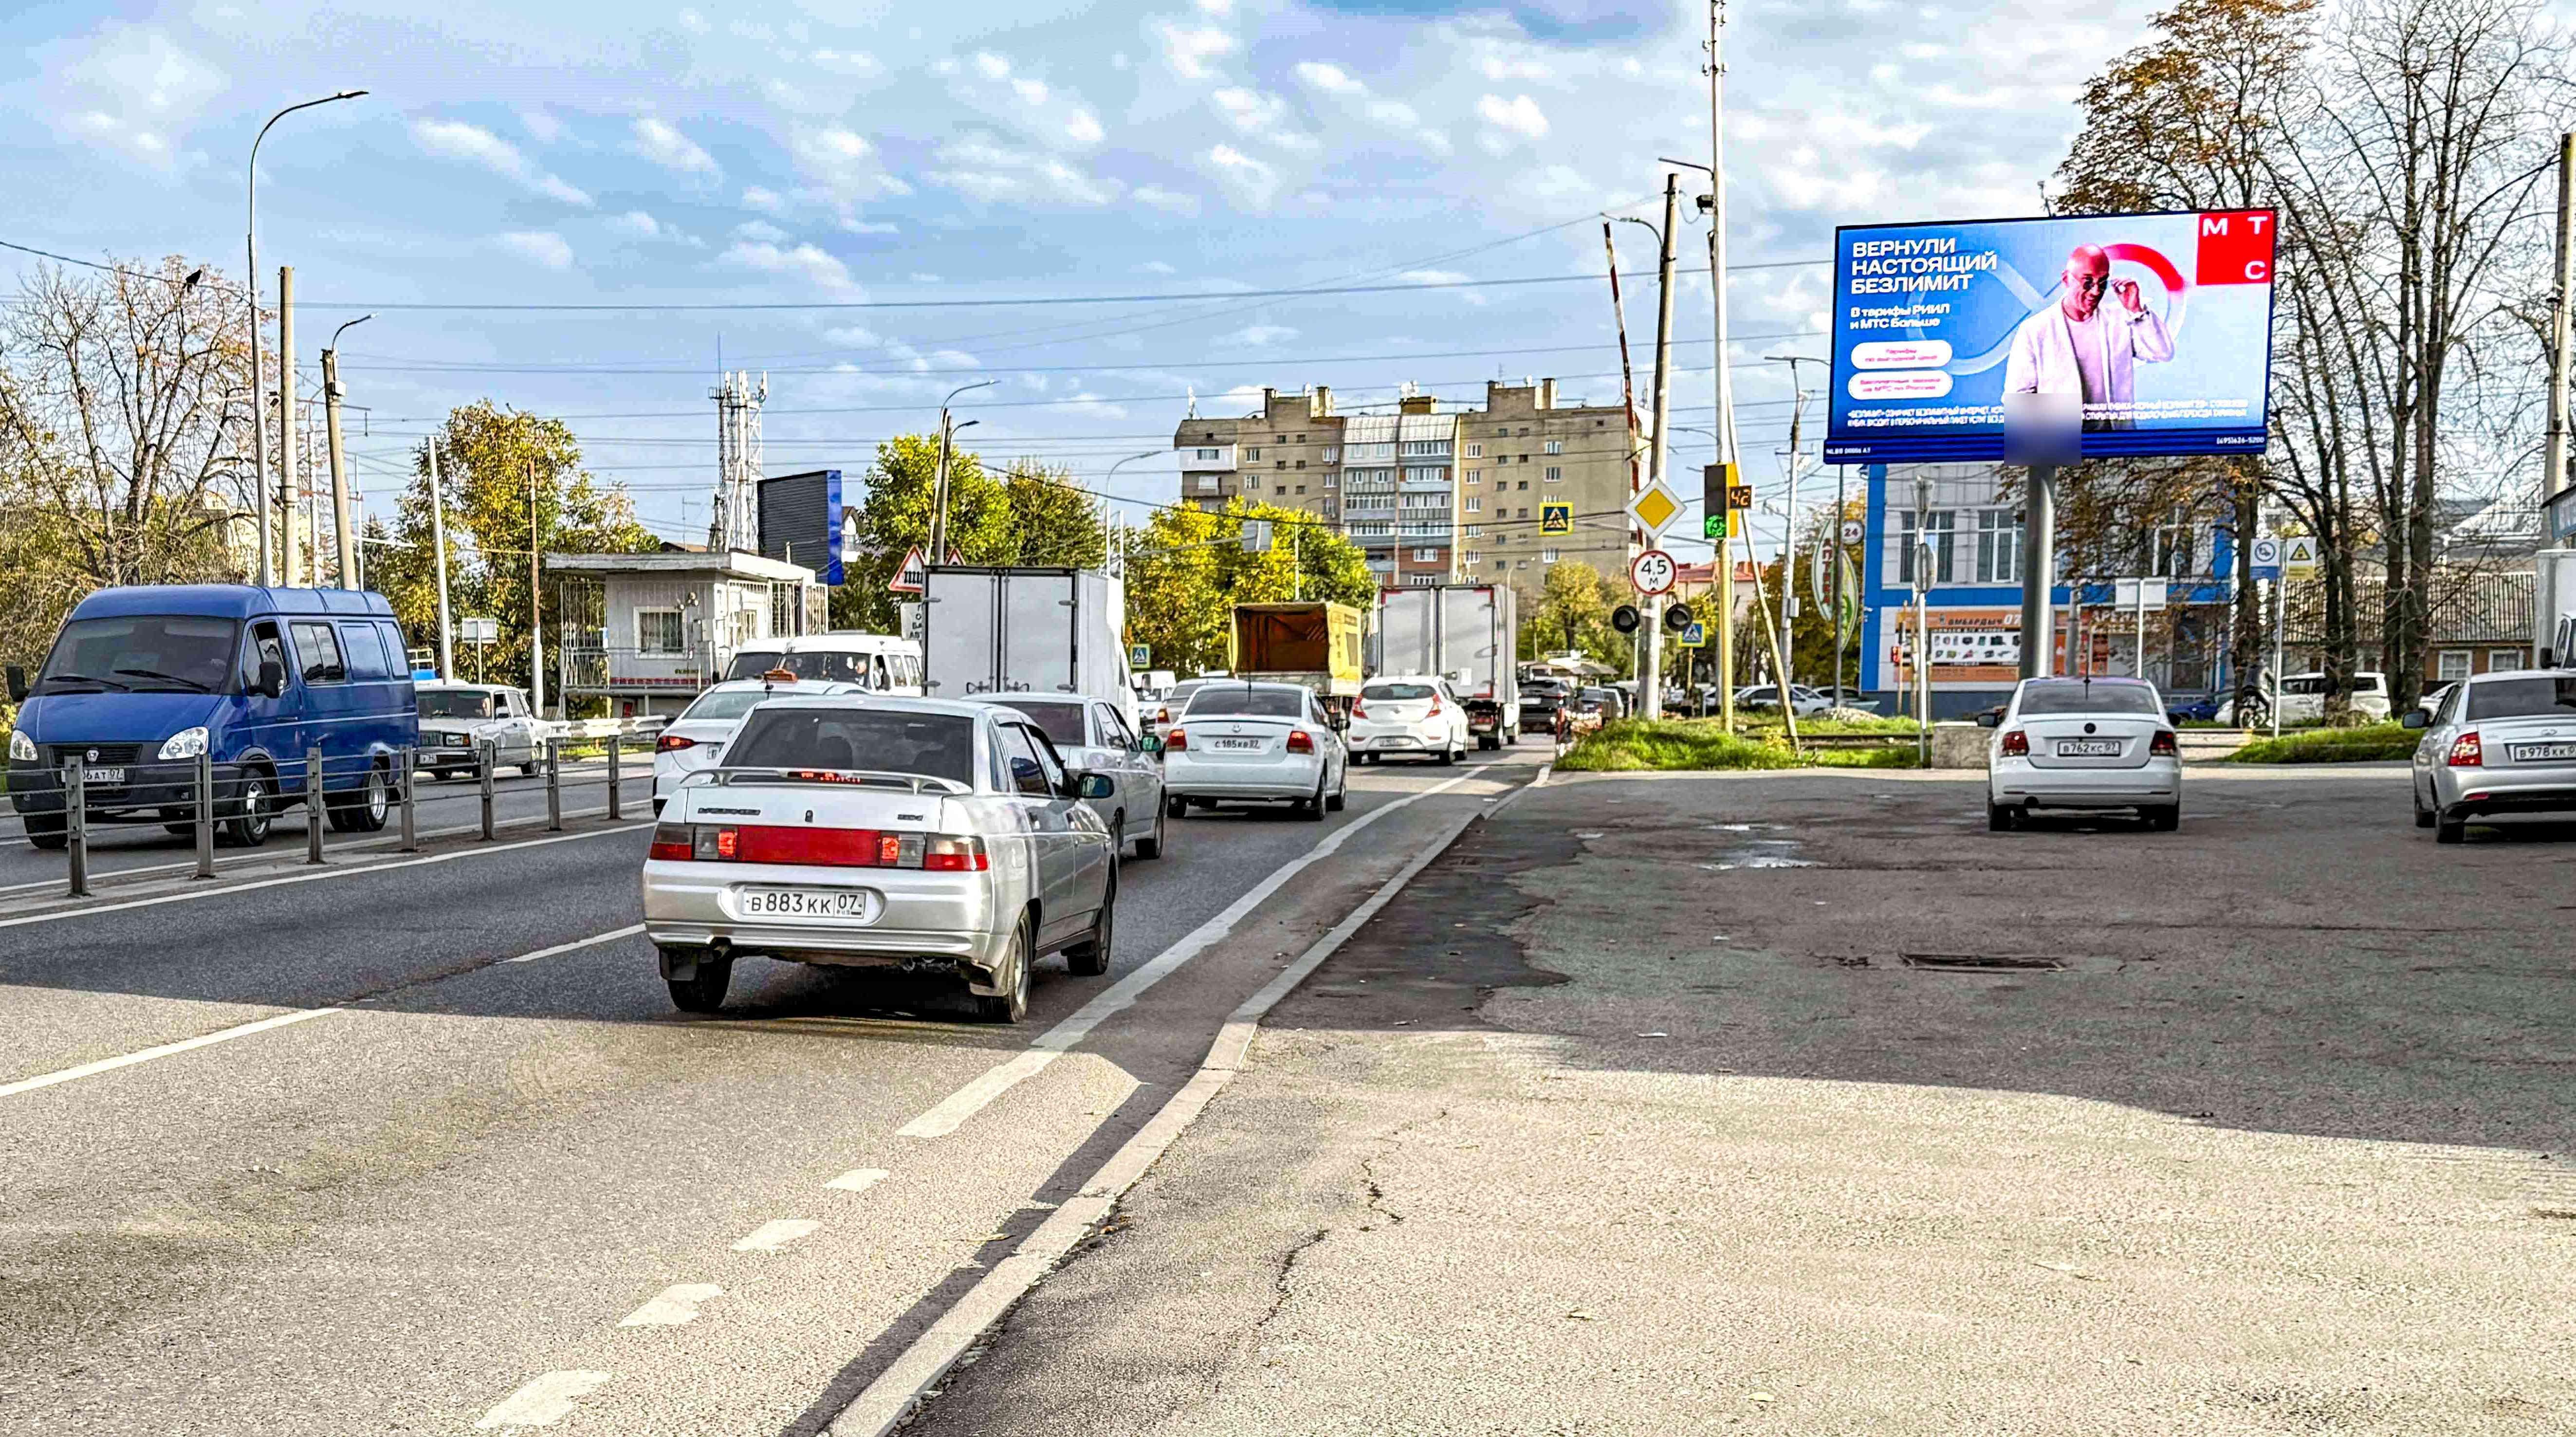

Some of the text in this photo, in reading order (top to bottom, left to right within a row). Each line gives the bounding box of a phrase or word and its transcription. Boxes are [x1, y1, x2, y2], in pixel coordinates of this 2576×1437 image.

[1853, 238, 1956, 258] ВЕРНУЛИ
[1852, 250, 1997, 276] НАСТОЯЩИЙ
[1851, 274, 1974, 294] БЕЗЛИМИТ
[1851, 303, 1950, 318] В тарифы РИИЛ
[1850, 317, 1941, 330] и МТС Больше
[1731, 488, 1751, 506] 42
[1844, 528, 1858, 537] 24
[2003, 613, 2022, 626] 07
[2520, 747, 2565, 758] В978КК
[751, 893, 858, 914] В883КК 07
